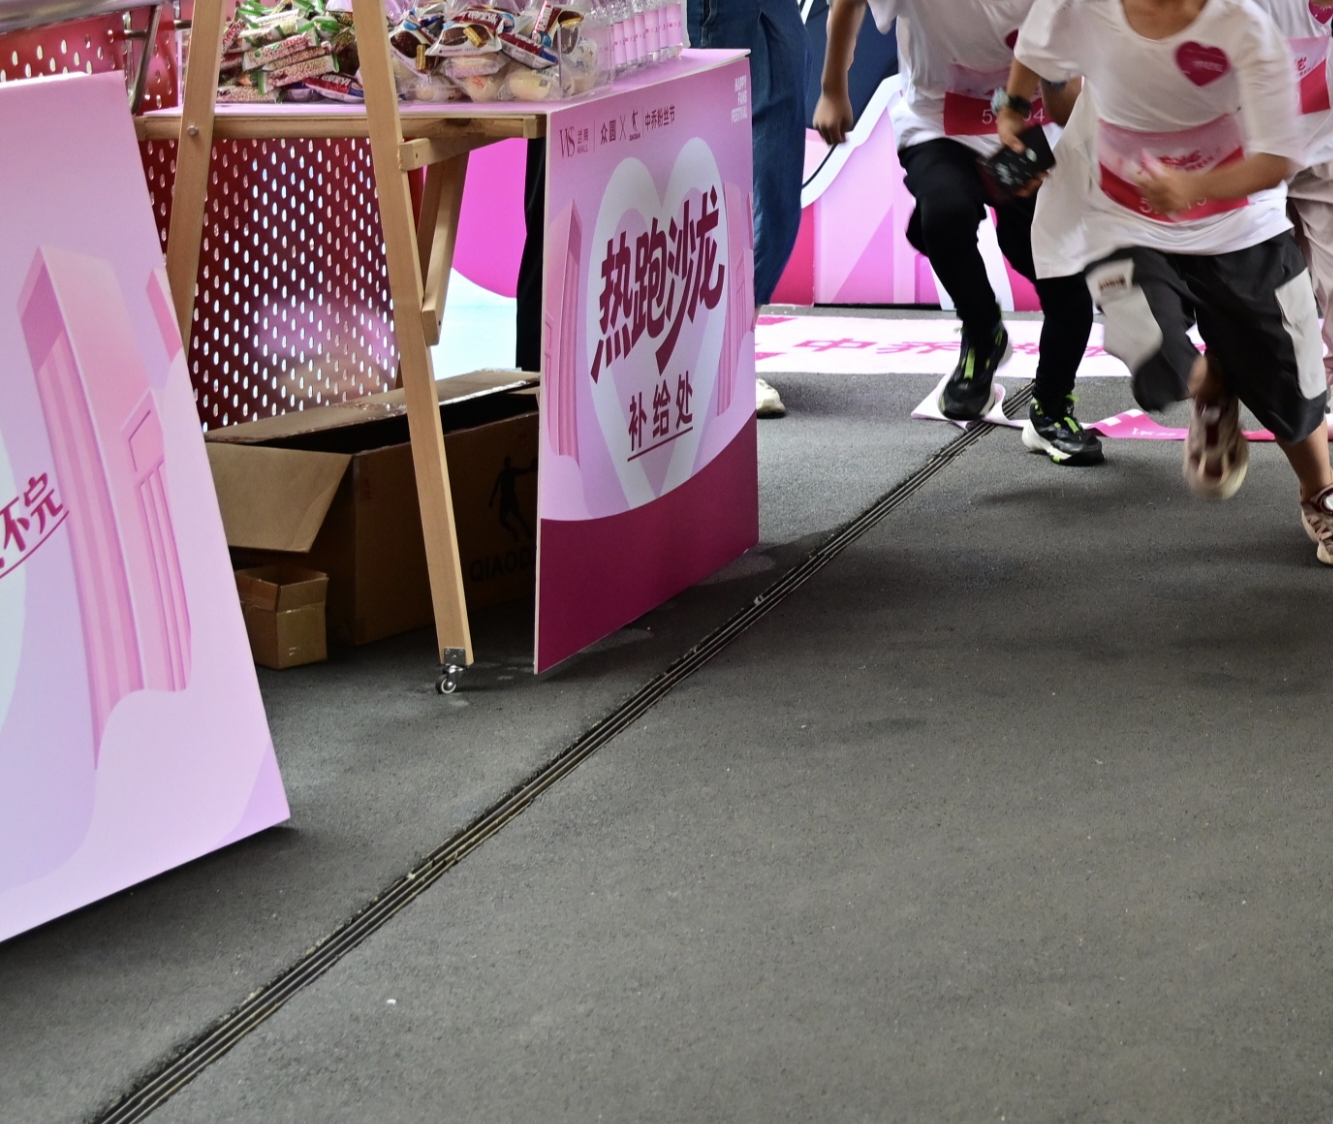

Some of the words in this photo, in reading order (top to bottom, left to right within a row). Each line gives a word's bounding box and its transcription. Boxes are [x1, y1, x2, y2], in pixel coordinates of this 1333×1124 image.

[981, 107, 1046, 126] 504
[590, 185, 726, 385] 热跑沙龙
[627, 370, 694, 452] 补给处
[0, 472, 67, 562] 不完
[468, 547, 534, 583] QIAOD
